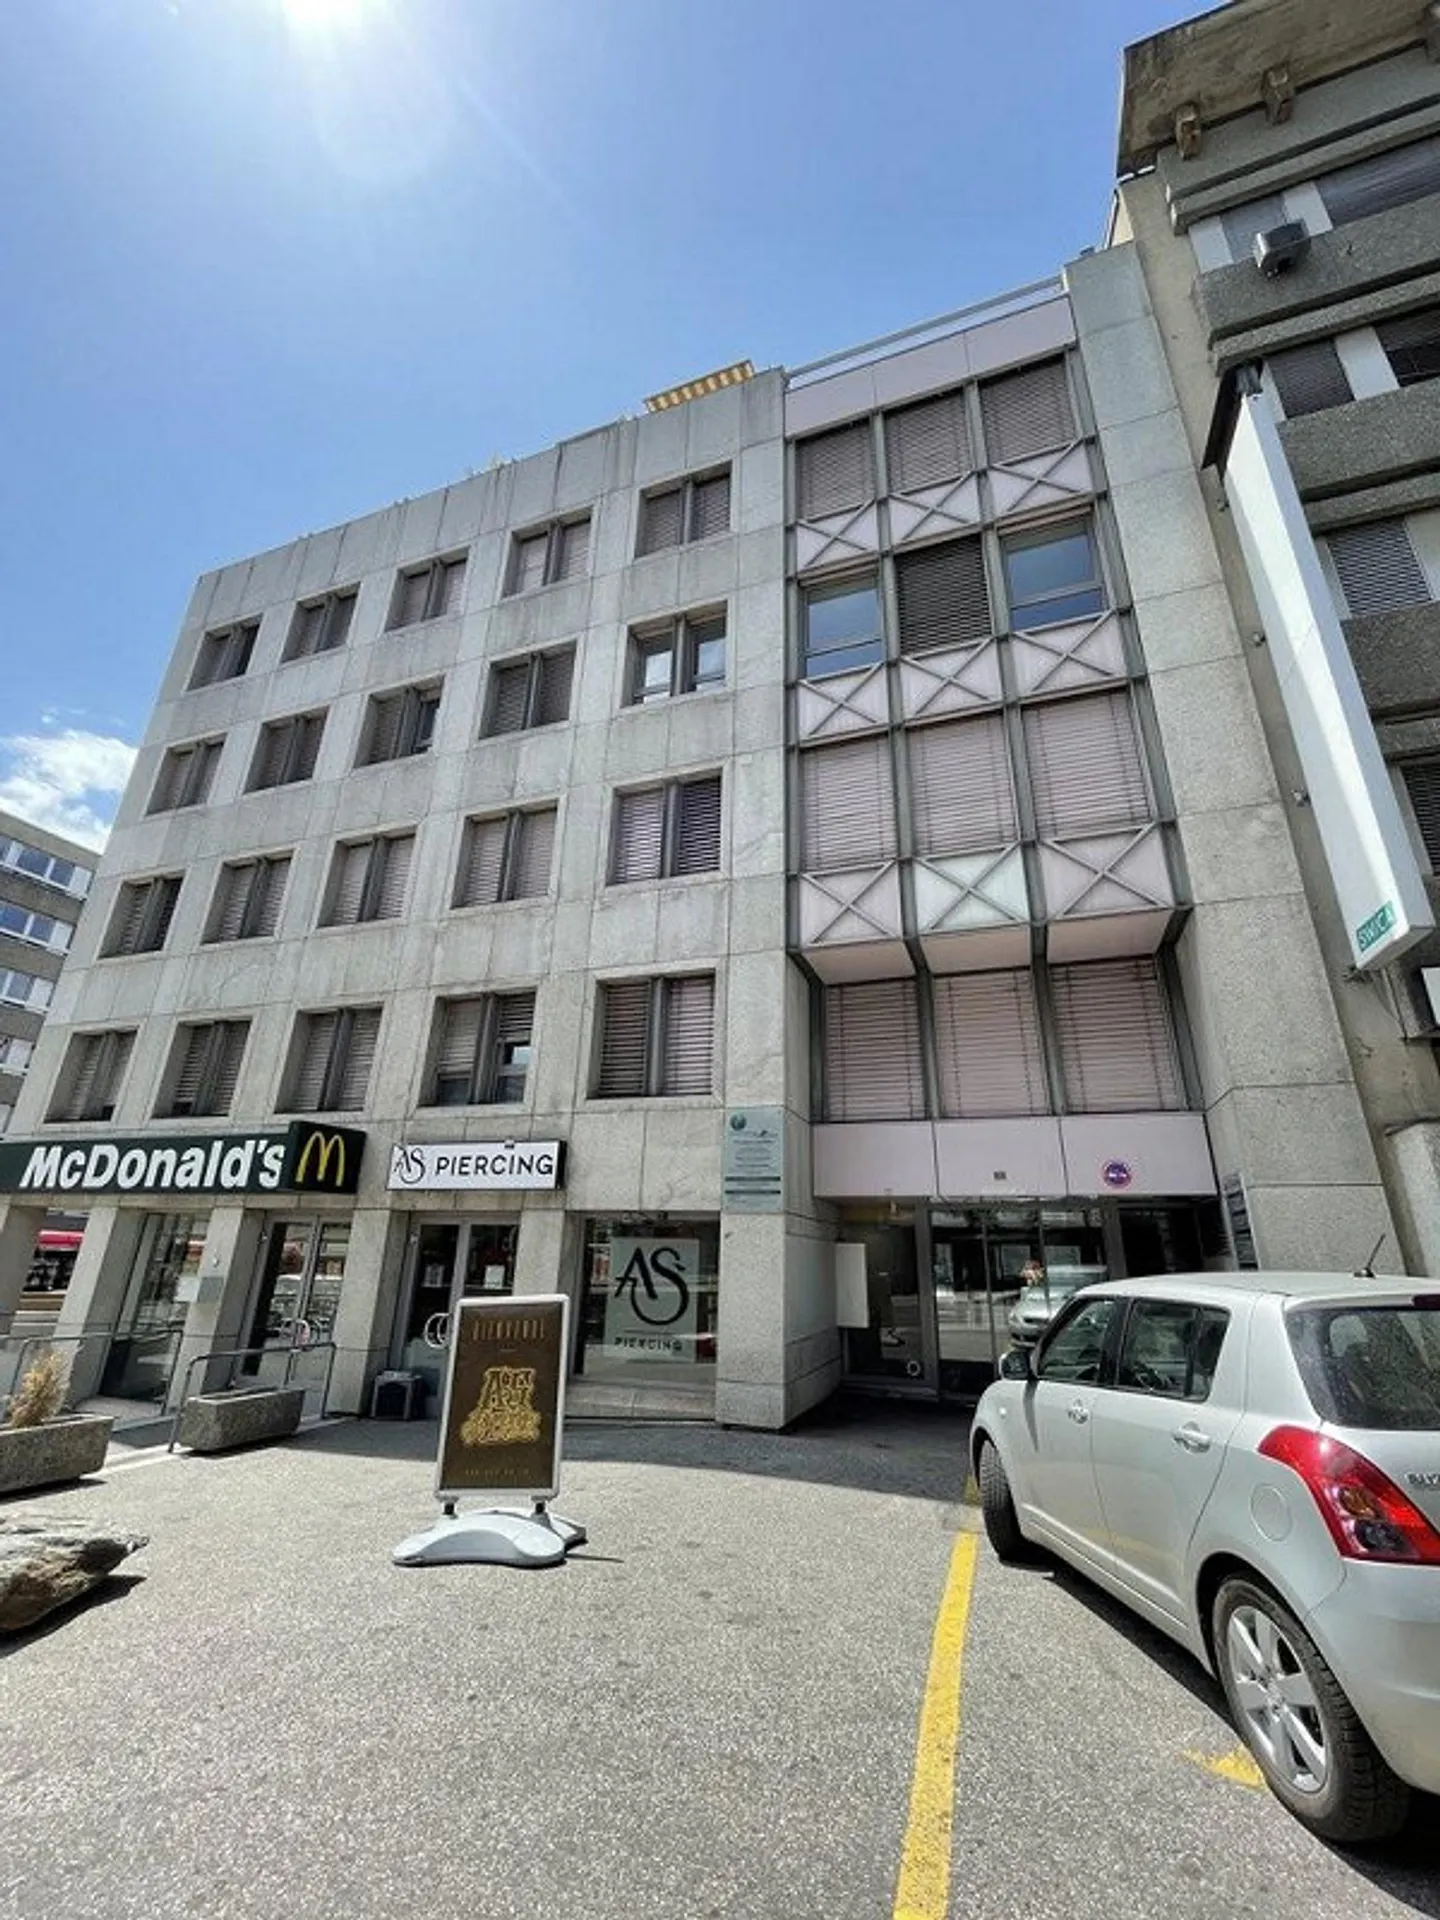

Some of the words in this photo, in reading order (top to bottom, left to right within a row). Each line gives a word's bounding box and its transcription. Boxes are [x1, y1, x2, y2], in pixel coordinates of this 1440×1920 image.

[19, 1140, 286, 1190] McDonald's
[393, 1147, 426, 1185] AS
[435, 1154, 554, 1177] PIERCING
[614, 1247, 690, 1326] AS
[614, 1337, 683, 1351] PIERCING
